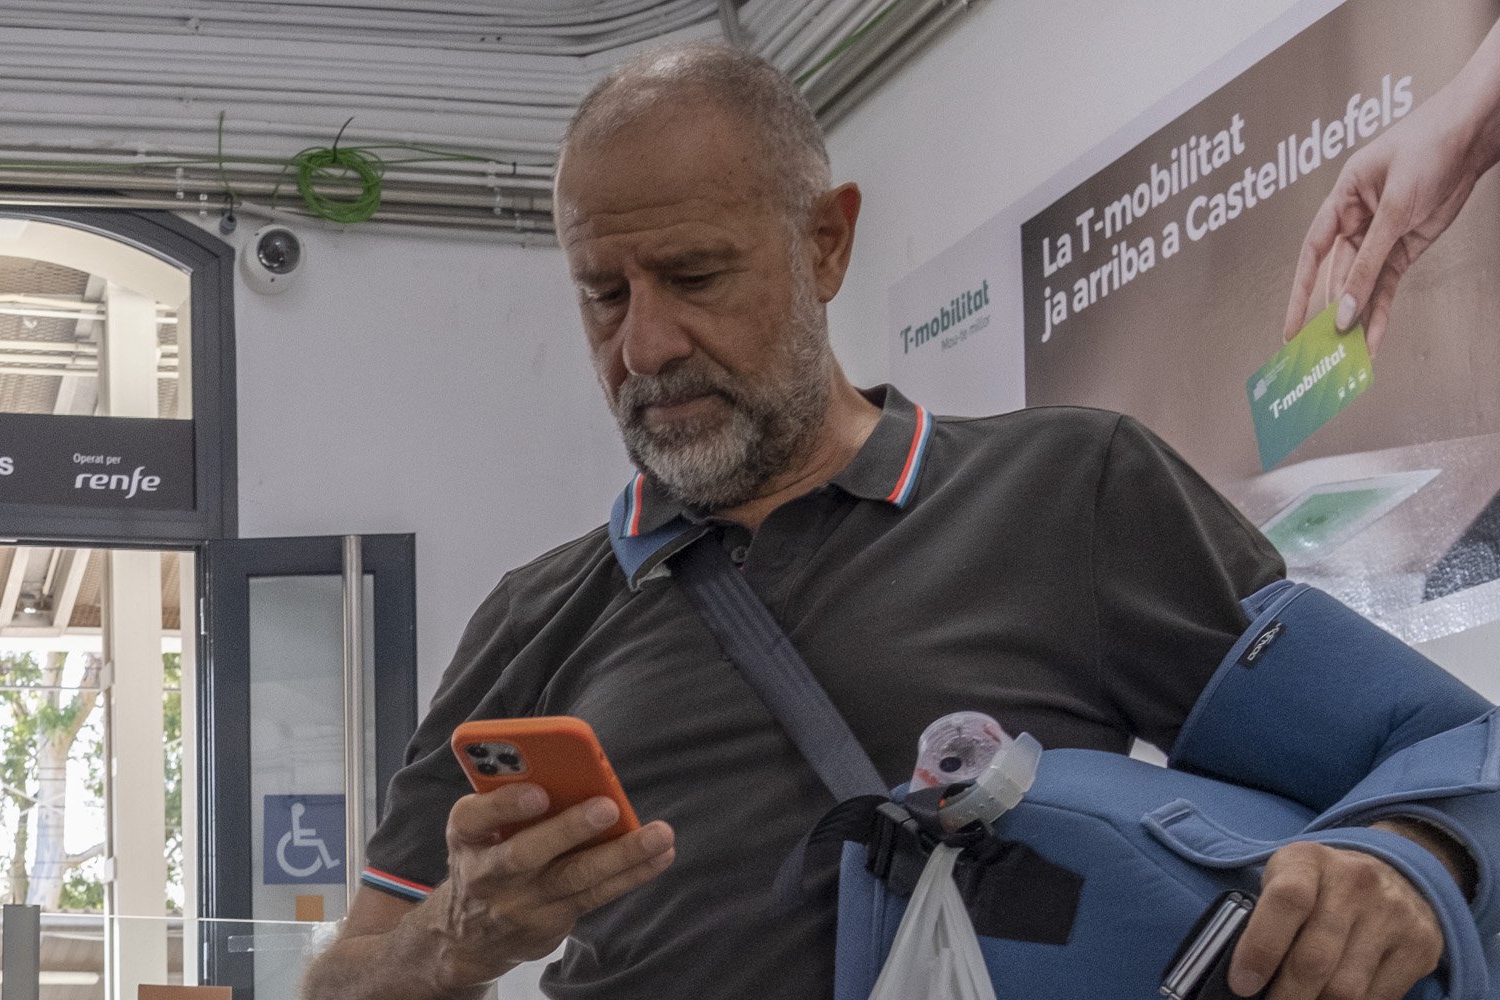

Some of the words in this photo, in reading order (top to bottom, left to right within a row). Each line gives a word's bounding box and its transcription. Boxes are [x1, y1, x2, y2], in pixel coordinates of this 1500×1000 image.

[1041, 286, 1068, 342] ja
[1072, 236, 1155, 313] arriba
[1162, 221, 1180, 258] a
[1186, 73, 1413, 242] Castelldefels
[1042, 233, 1072, 277] La
[1076, 112, 1245, 254] T-mobilitat
[901, 279, 989, 354] T-mobilitat
[1269, 343, 1346, 418] T-mobilitat
[73, 453, 103, 465] Operat
[105, 455, 122, 466] per
[74, 466, 161, 499] renfe
